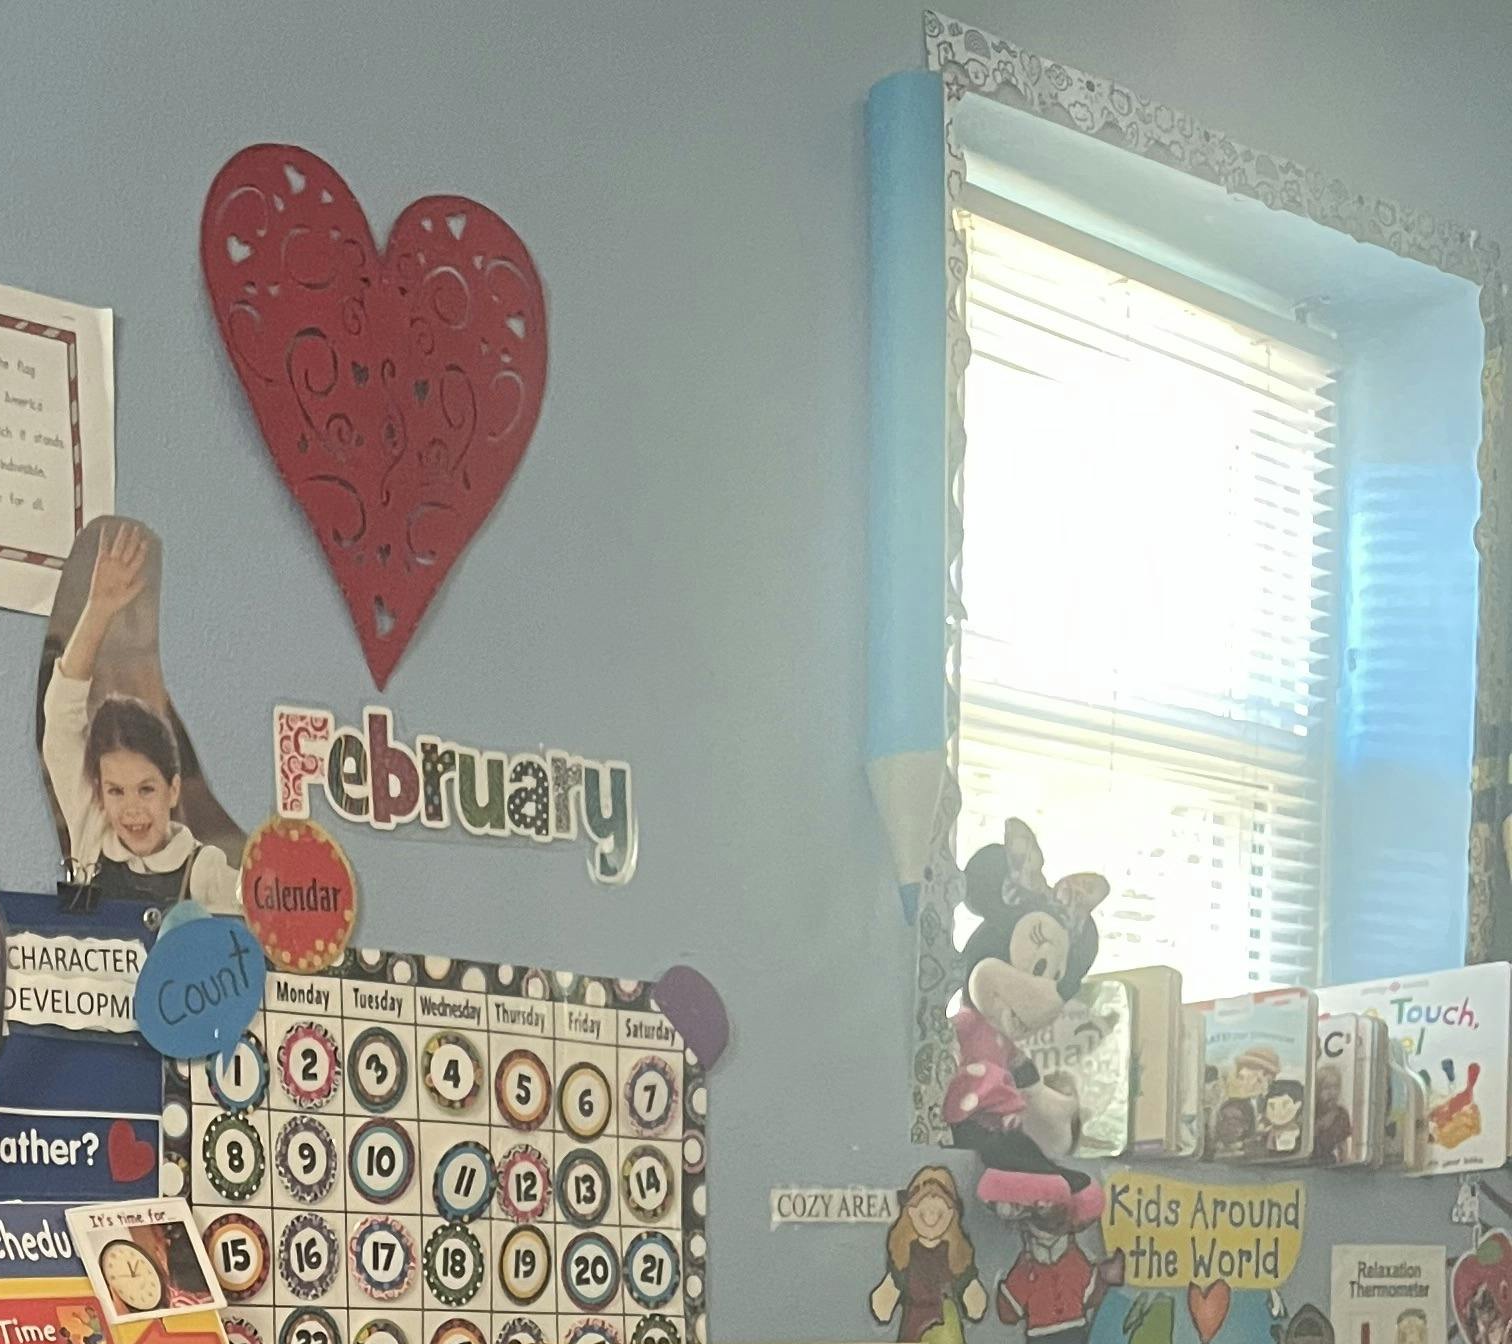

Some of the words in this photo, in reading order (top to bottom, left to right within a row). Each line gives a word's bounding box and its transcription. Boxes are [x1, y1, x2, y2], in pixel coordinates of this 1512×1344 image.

[276, 706, 634, 880] February
[253, 875, 344, 914] Calendar
[7, 945, 139, 974] CHARACTER
[159, 930, 251, 1026] Count
[5, 986, 137, 1020] DEVELOPM
[276, 981, 331, 1010] Monday
[352, 987, 403, 1018] Tuesday
[419, 994, 482, 1026] Wednesday
[494, 1002, 546, 1034] Thursday
[568, 1011, 602, 1040] Friday
[626, 1018, 676, 1047] Saturday
[1390, 996, 1480, 1030] Touch,
[233, 1054, 242, 1087] 1
[300, 1048, 318, 1081] 2
[365, 1053, 388, 1085] 3
[442, 1059, 461, 1089] 4
[515, 1073, 532, 1106] 5
[578, 1088, 594, 1118] 6
[643, 1084, 657, 1113] 7
[226, 1140, 245, 1174] 8
[298, 1142, 317, 1175] 9
[366, 1145, 396, 1178] 10
[454, 1165, 477, 1198] 11
[514, 1171, 538, 1202] 12
[574, 1173, 596, 1205] 13
[636, 1165, 661, 1200] 14
[89, 1213, 114, 1228] It's
[117, 1211, 144, 1225] time
[777, 1193, 834, 1219] COZY
[838, 1194, 892, 1218] AREA
[1108, 1183, 1181, 1229] Kids
[1189, 1188, 1301, 1230] Around
[221, 1237, 251, 1273] 15
[295, 1237, 322, 1273] 16
[371, 1240, 398, 1272] 17
[442, 1247, 467, 1279] 18
[514, 1248, 537, 1279] 19
[574, 1255, 609, 1286] 20
[640, 1254, 664, 1286] 21
[1130, 1236, 1179, 1280] the
[1190, 1236, 1280, 1280] World
[1357, 1260, 1422, 1279] Relaxation
[1349, 1281, 1432, 1301] Thermometer
